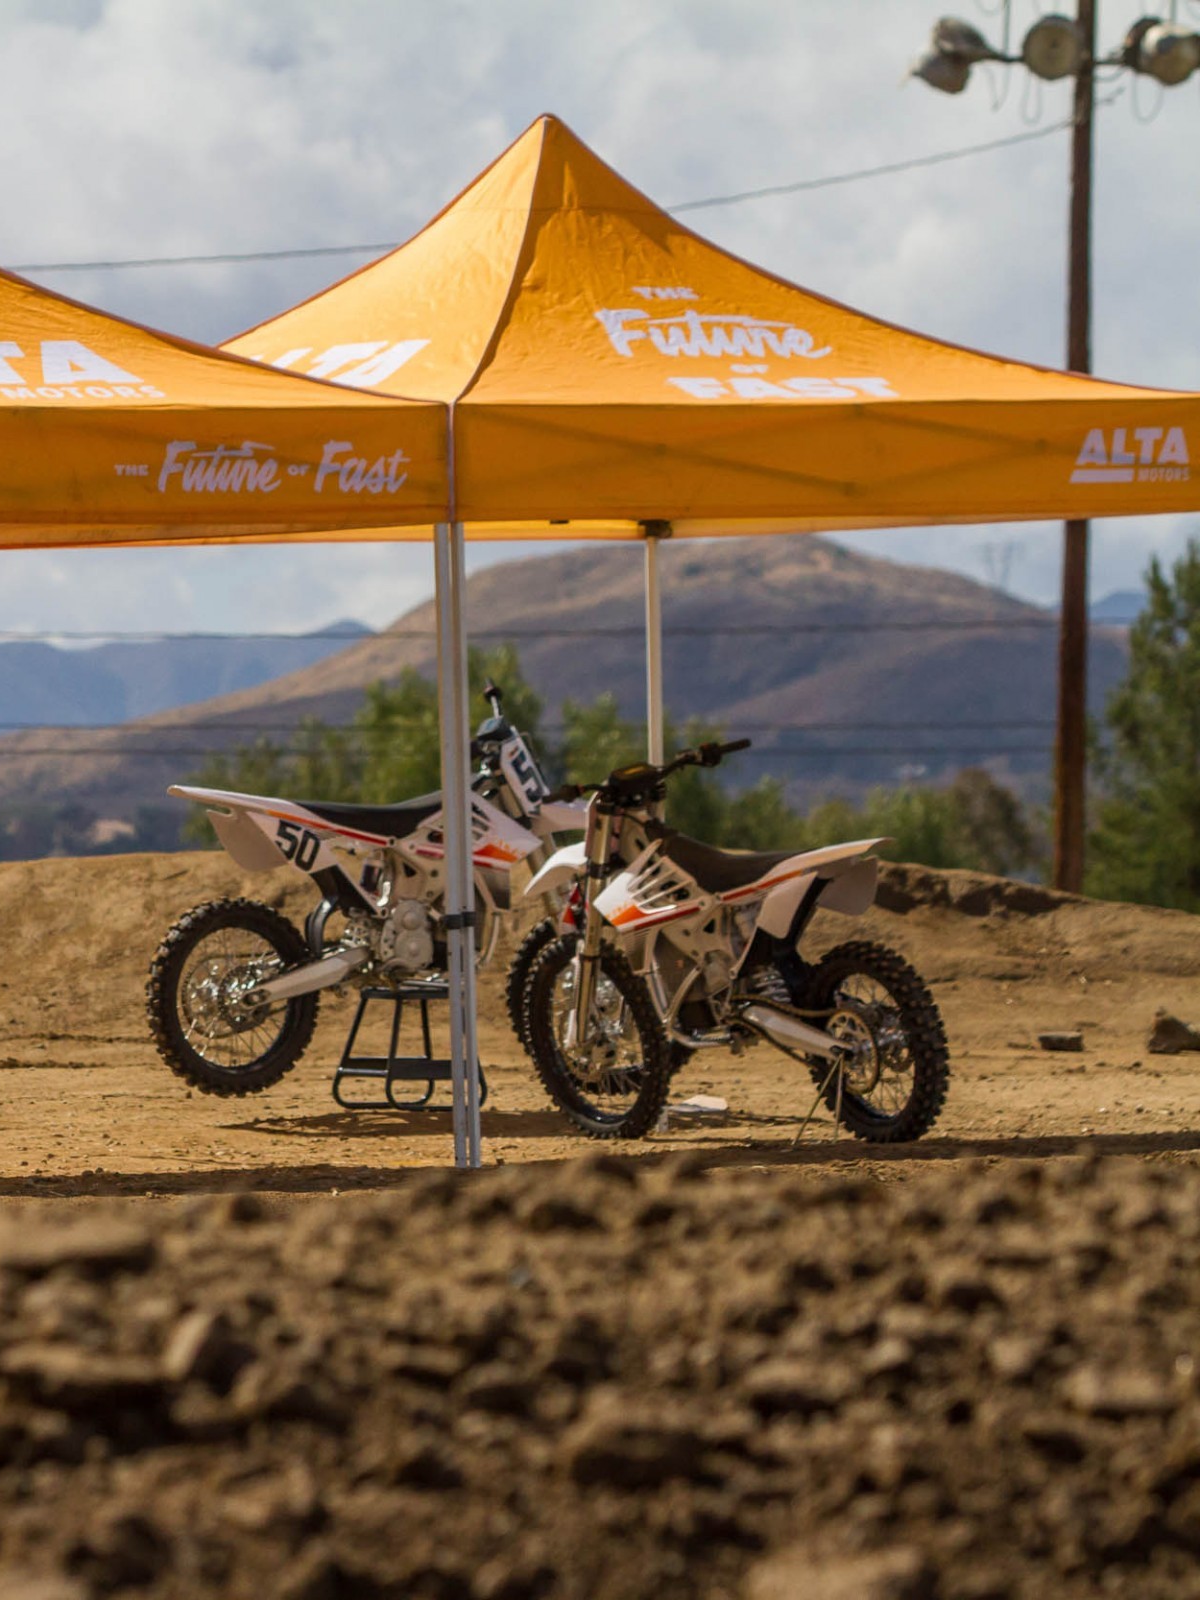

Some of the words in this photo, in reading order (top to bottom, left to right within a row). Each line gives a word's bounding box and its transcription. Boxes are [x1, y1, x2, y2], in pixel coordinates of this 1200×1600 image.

[631, 286, 699, 300] THE
[594, 308, 832, 359] Future
[0, 385, 166, 400] MOTORS
[666, 376, 901, 399] FAST
[1075, 426, 1190, 466] ALTA
[114, 464, 149, 476] THE
[158, 440, 282, 494] Future
[313, 440, 411, 494] Fast
[1137, 466, 1190, 482] MOTORS
[275, 819, 320, 871] 50
